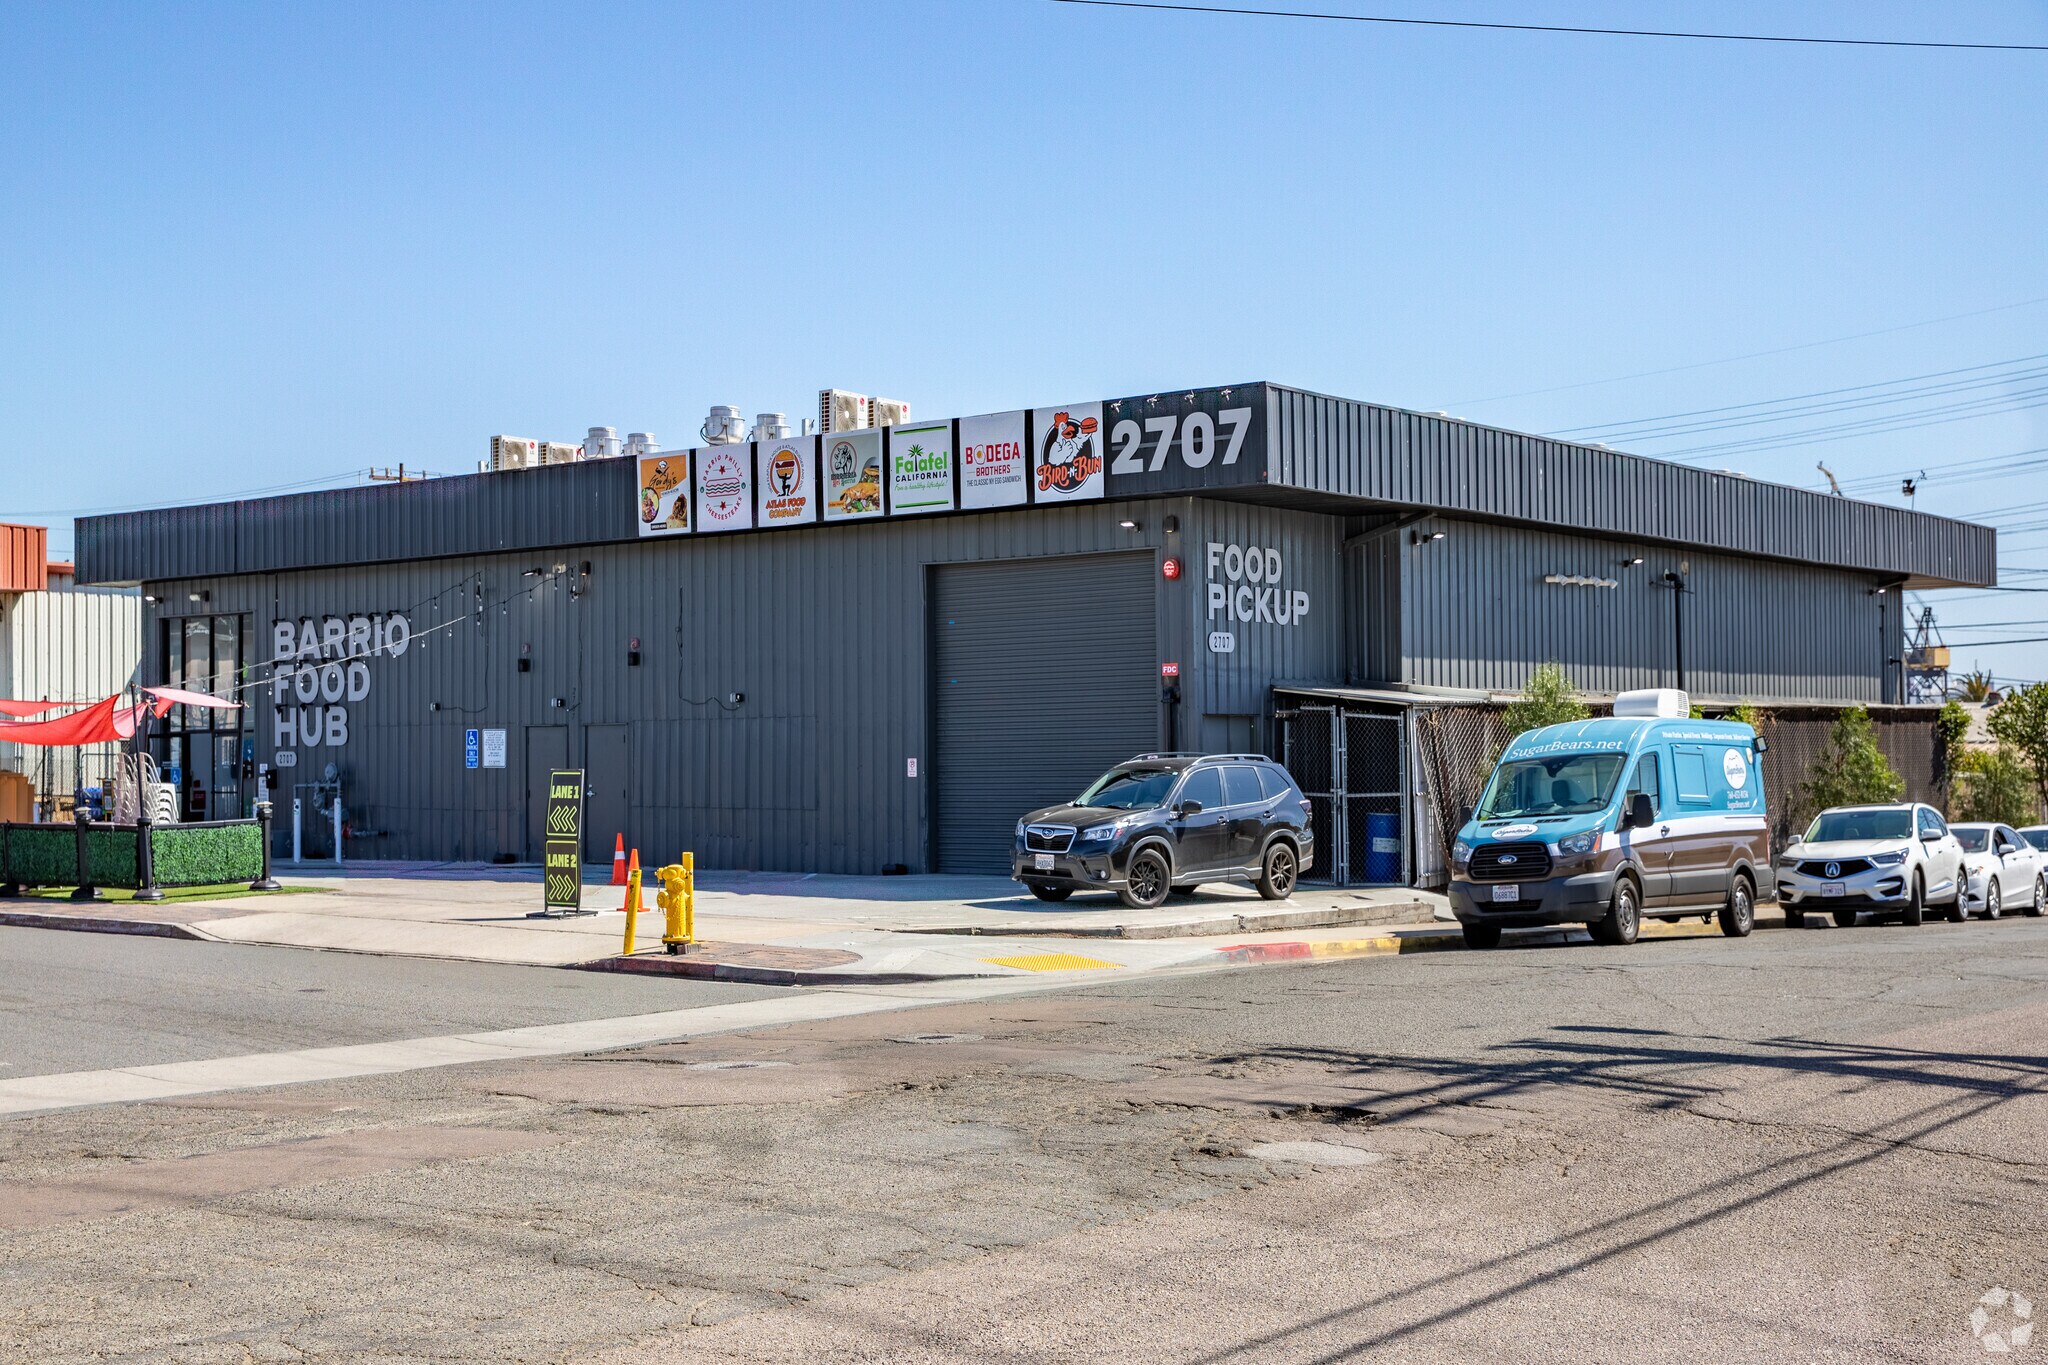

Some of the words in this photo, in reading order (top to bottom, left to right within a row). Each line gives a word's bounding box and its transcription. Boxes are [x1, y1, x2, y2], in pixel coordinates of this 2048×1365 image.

[1111, 406, 1252, 475] 2707
[895, 450, 948, 474] Falafel
[965, 441, 1021, 465] BODEGA
[702, 454, 722, 481] BARRIO
[724, 454, 743, 477] PHILLY
[895, 471, 948, 482] CALIFORNIA
[976, 464, 1011, 477] BROTHERS
[705, 496, 743, 520] CHEESESTEAKS
[766, 498, 787, 509] ATLAS
[787, 497, 806, 507] FOOD
[768, 506, 803, 519] COMPANY
[1207, 542, 1282, 584] FOOD
[1207, 583, 1310, 626] PICKUP
[274, 614, 411, 660] BARRIO
[1213, 636, 1230, 649] 2707
[1162, 665, 1177, 673] FDC
[274, 661, 371, 704] FOOD
[274, 706, 349, 747] HUB
[279, 754, 293, 764] 2707
[1510, 740, 1624, 759] SugarBears.net
[551, 785, 573, 799] LANE
[573, 785, 580, 799] 1
[547, 854, 570, 867] LANE
[570, 854, 577, 868] 2
